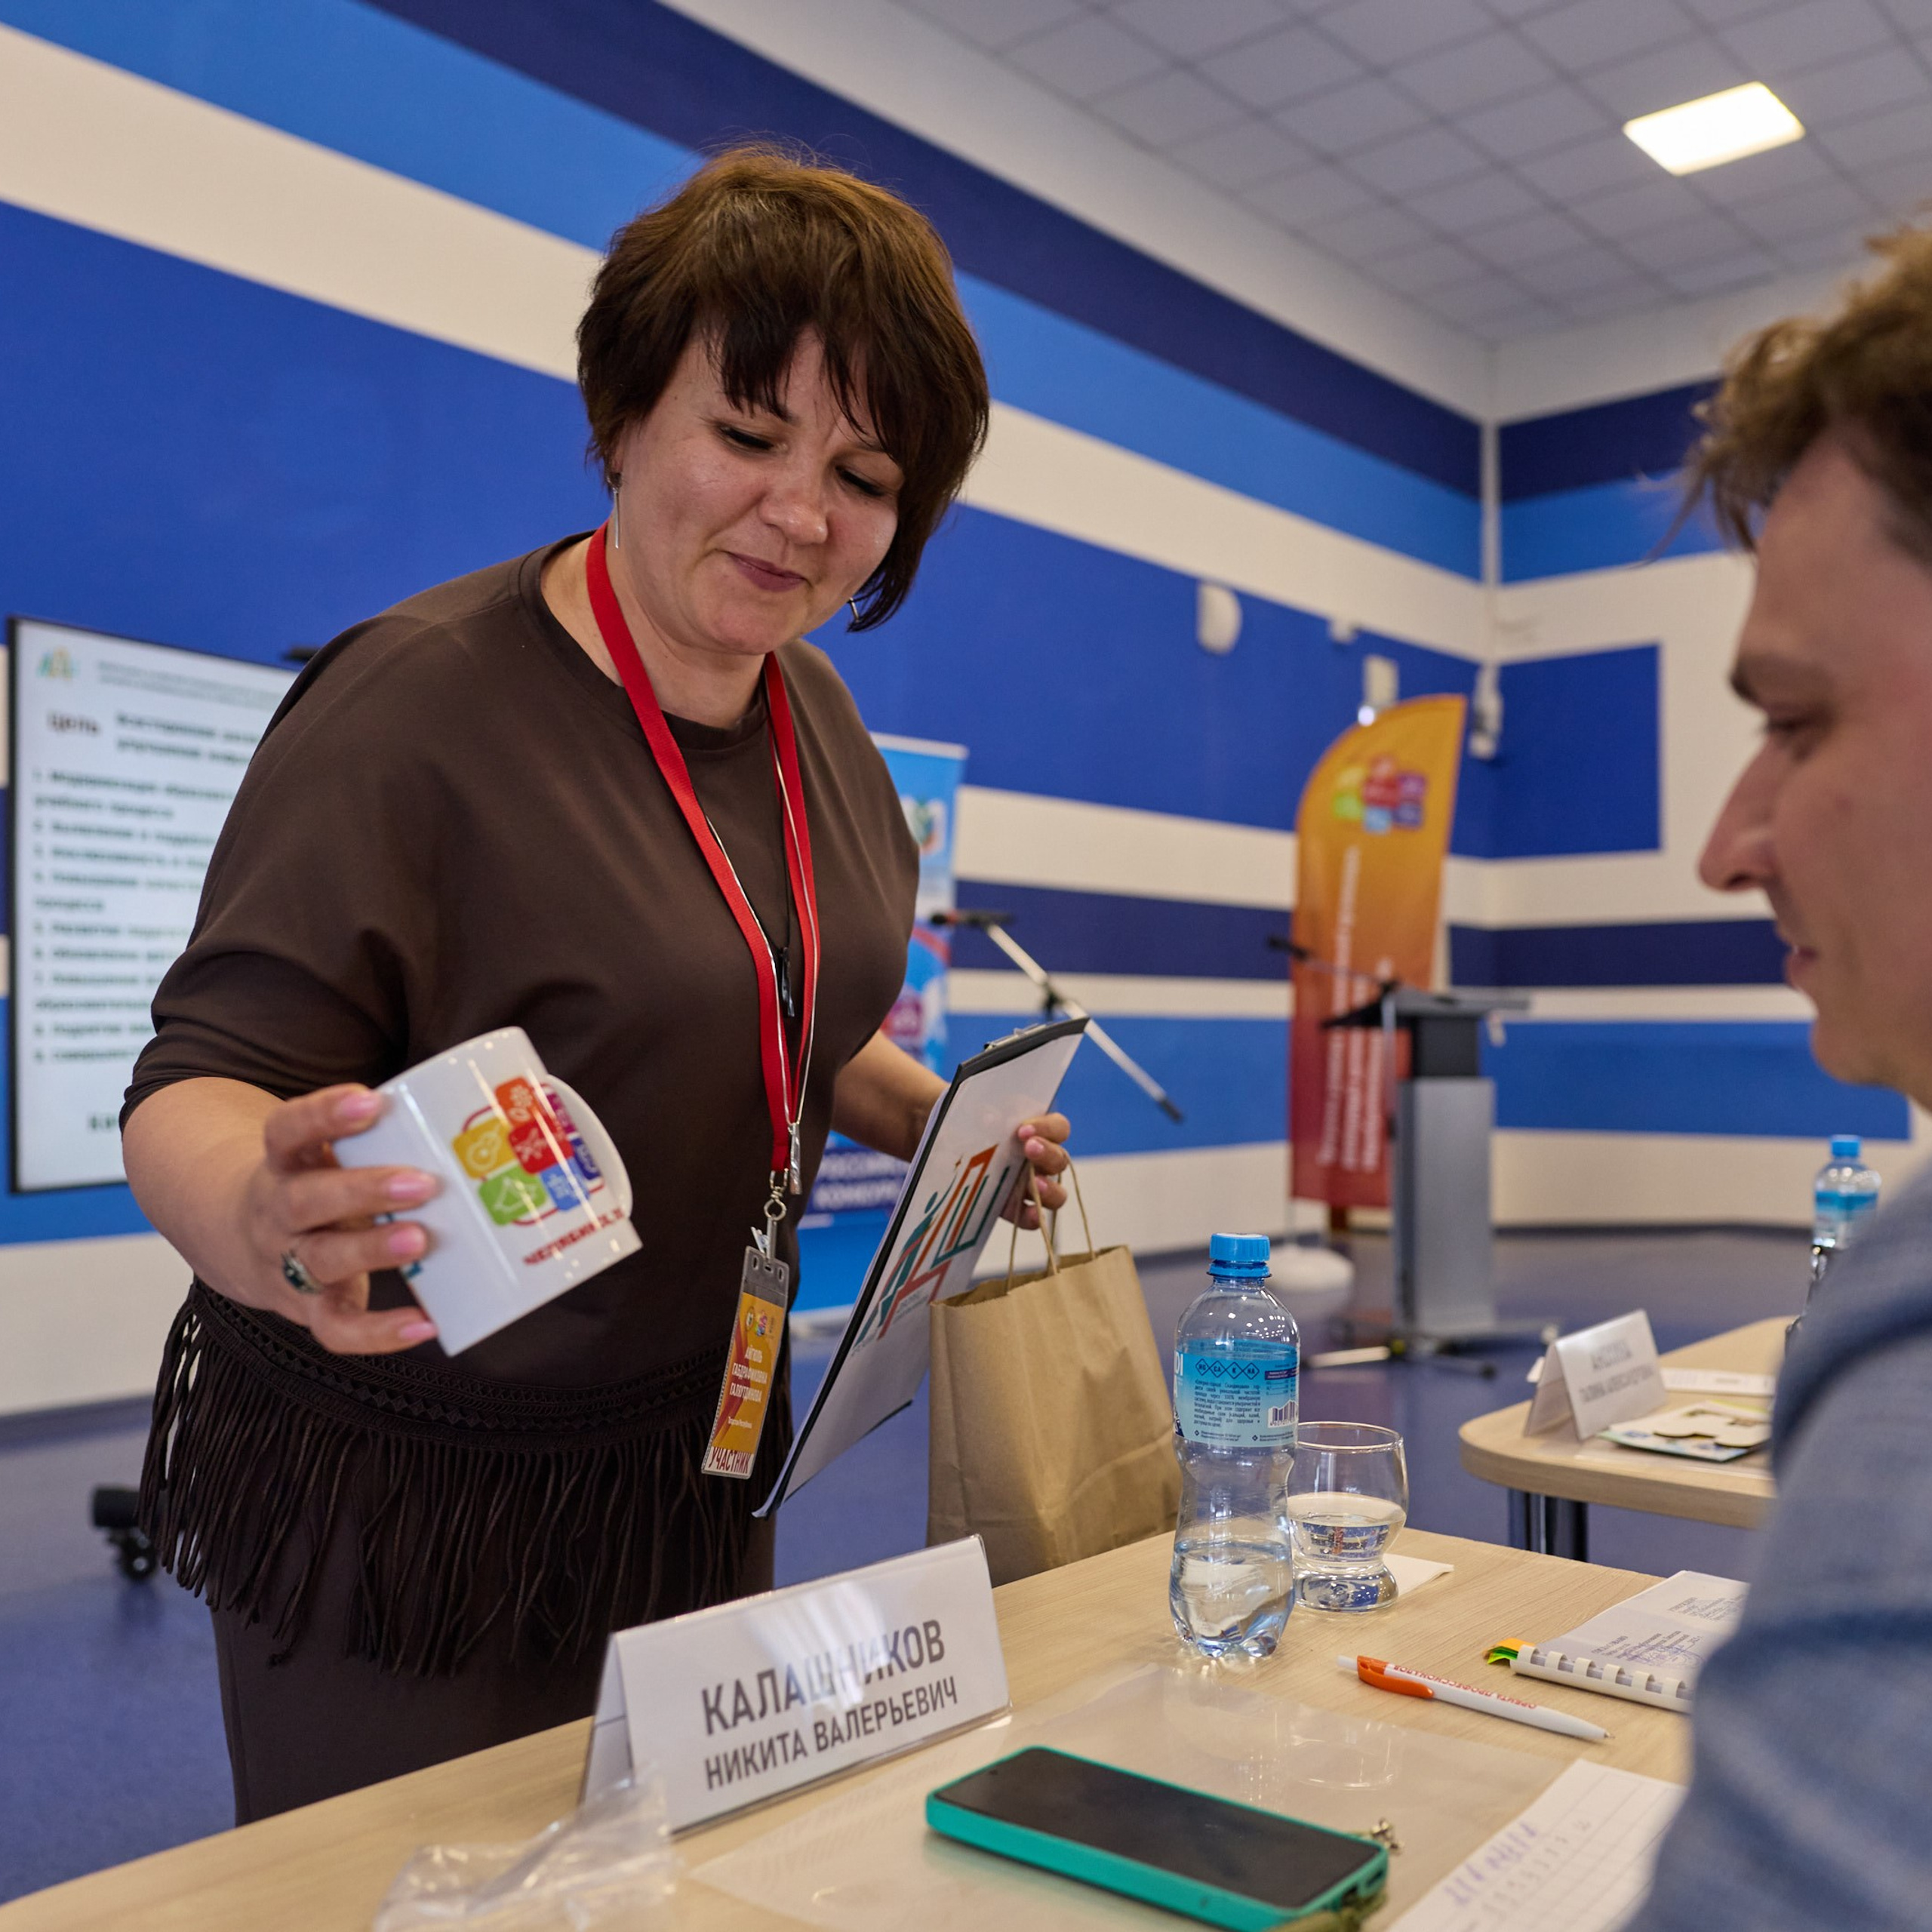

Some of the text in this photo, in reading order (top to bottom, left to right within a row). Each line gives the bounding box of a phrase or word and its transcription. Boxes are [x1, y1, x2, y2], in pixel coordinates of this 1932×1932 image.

[708, 1446, 751, 1474] УЧАСТНИК
[704, 1675, 958, 1791] НИКИТА ВАЛЕРЬЕВИЧ
